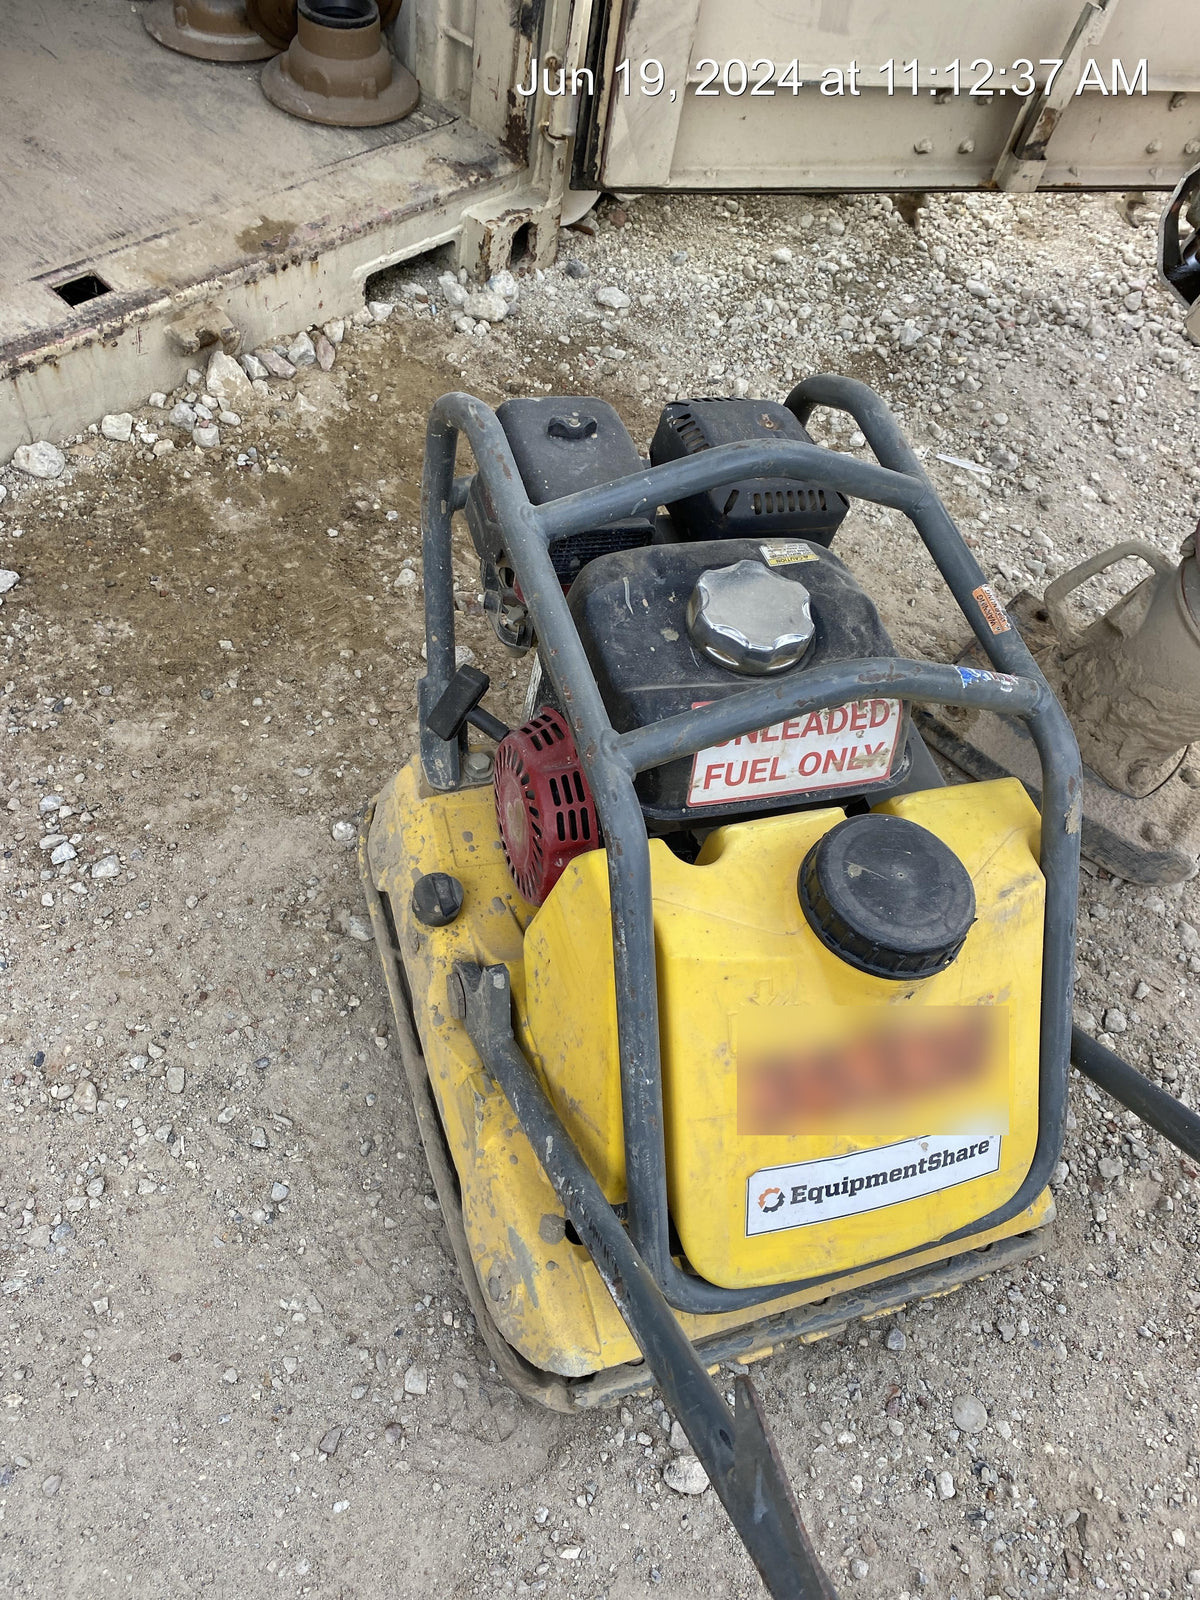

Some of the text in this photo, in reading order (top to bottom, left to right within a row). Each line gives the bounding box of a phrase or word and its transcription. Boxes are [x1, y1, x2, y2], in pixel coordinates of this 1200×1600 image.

[976, 594, 997, 627] WARNING
[714, 699, 891, 747] LEADED
[703, 741, 886, 790] FUEL ONLY
[790, 1139, 990, 1204] EquipmentShare
